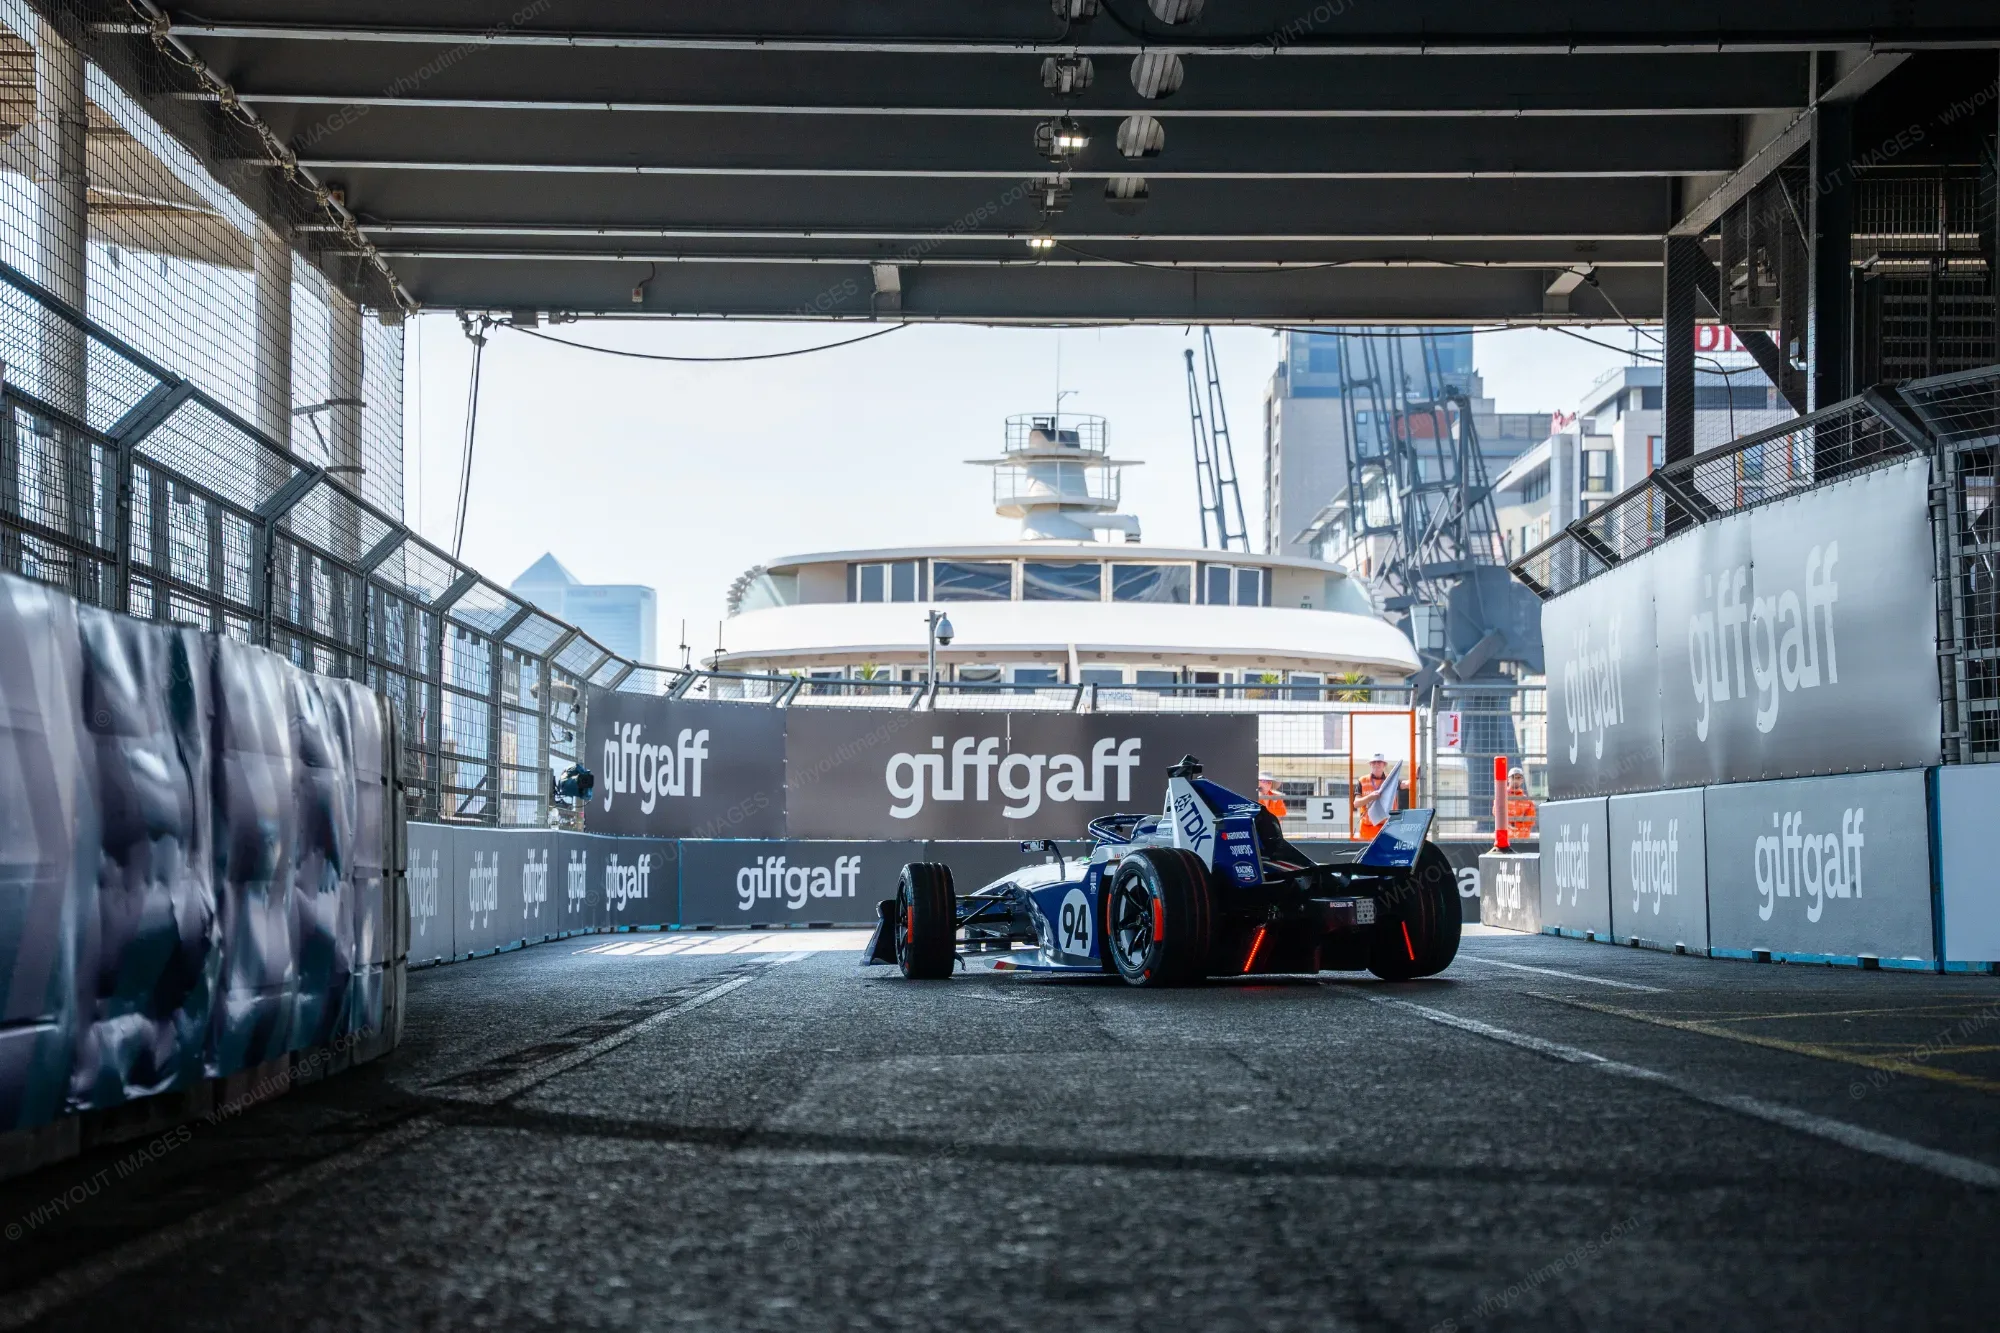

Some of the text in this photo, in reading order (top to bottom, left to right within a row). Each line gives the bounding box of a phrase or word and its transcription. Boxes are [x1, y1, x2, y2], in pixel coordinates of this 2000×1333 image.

[1688, 540, 1839, 742] giffgaff
[1564, 615, 1625, 765] giffgaff
[603, 721, 709, 815] giffgaff
[885, 736, 1140, 819] giffgaff
[1180, 801, 1212, 852] TDK
[1322, 803, 1334, 819] 5
[469, 851, 498, 930] giffgaff
[523, 848, 548, 919] giffgaff
[606, 854, 650, 912] giffgaff
[737, 855, 861, 911] giffgaff
[1554, 823, 1590, 907] giffgaff
[1631, 818, 1679, 915] giffgaff
[1754, 808, 1864, 923] giffgaff
[1063, 903, 1088, 949] 94
